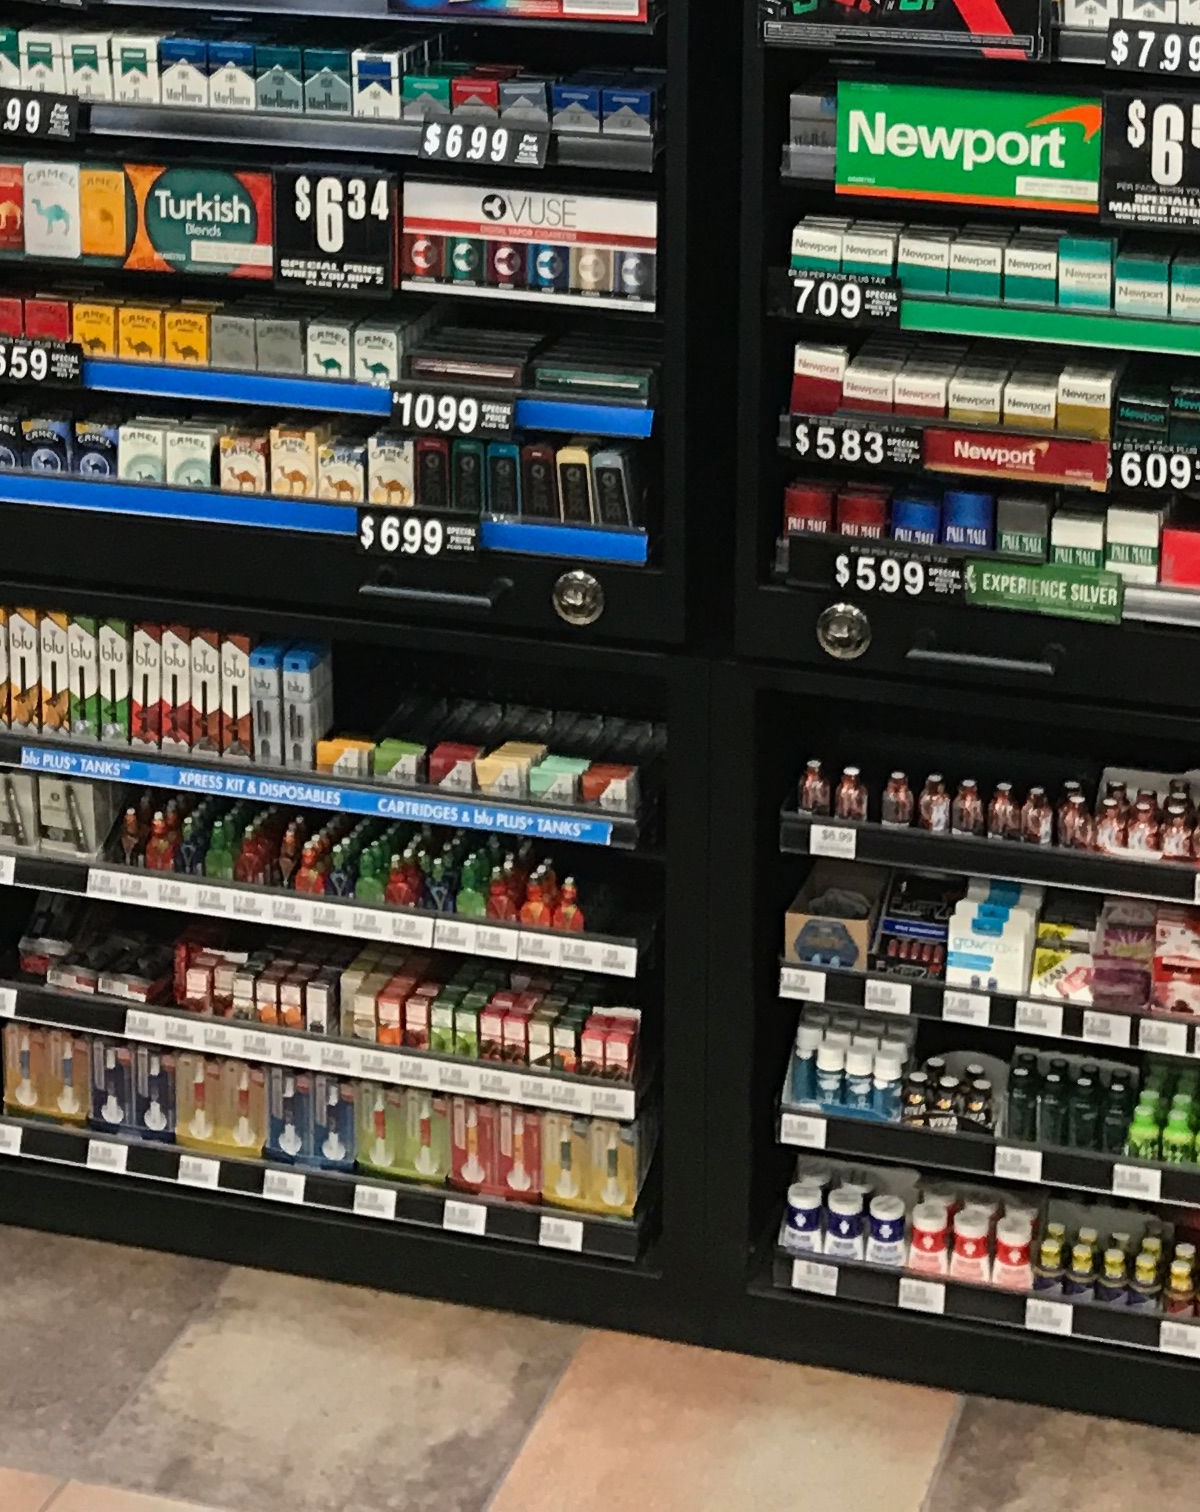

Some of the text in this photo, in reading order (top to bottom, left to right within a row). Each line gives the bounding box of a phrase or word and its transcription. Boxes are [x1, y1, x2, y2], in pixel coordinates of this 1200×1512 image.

[424, 122, 508, 162] $6.99
[848, 110, 1066, 171] Newport
[27, 168, 75, 188] CAMEL
[155, 189, 250, 224] Turkish
[507, 195, 576, 227] VUSE
[1108, 201, 1167, 215] MARKED
[186, 222, 221, 237] Blends
[795, 237, 838, 255] Newport
[845, 243, 888, 258] Newport
[901, 247, 945, 263] Newport
[280, 259, 384, 274] SPECIAL PRICE
[953, 253, 997, 268] Newport
[1008, 258, 1051, 272] Newport
[281, 269, 317, 279] WHEN
[320, 272, 345, 281] YOU
[347, 273, 372, 283] BUY
[1065, 266, 1107, 280] Newport
[794, 278, 897, 319] 7.09 SPECIAL
[1118, 285, 1163, 300] Newport
[310, 331, 347, 346] CAMEL
[357, 336, 395, 351] CAMEL
[798, 359, 839, 375] Newport
[847, 381, 888, 397] Newport
[898, 387, 941, 401] Newport
[1062, 388, 1105, 403] Newport
[952, 393, 995, 407] Newport
[1007, 398, 1051, 413] Newport
[392, 392, 511, 433] $10.99 SPECIAL
[485, 414, 507, 424] PRICE
[1120, 406, 1165, 423] Newport
[796, 424, 884, 464] $5.83
[954, 441, 1035, 465] Newport
[1107, 452, 1191, 489] 6.09
[788, 517, 827, 533] PALL MALL
[360, 515, 443, 555] $6.99
[947, 526, 986, 546] PALL MALL
[1002, 534, 1042, 553] PALL MALL
[1055, 547, 1096, 566] PALL MALL
[1111, 545, 1152, 563] PALL MALL
[835, 554, 924, 596] $5.99
[983, 572, 1067, 599] EXPERIENCE
[1070, 583, 1117, 606] SILVER
[12, 632, 33, 650] blu
[43, 637, 64, 654] blu
[71, 642, 92, 660] blu
[102, 644, 123, 662] blu
[136, 650, 157, 668] blu
[165, 650, 186, 668] blu
[194, 656, 215, 674] blu
[224, 661, 246, 679] blu
[22, 750, 40, 766] blu
[179, 771, 341, 806] XPRESS KIT & DISPOSABLES
[377, 798, 458, 821] CARTRIDGES
[461, 811, 470, 822] &
[474, 809, 493, 826] blu
